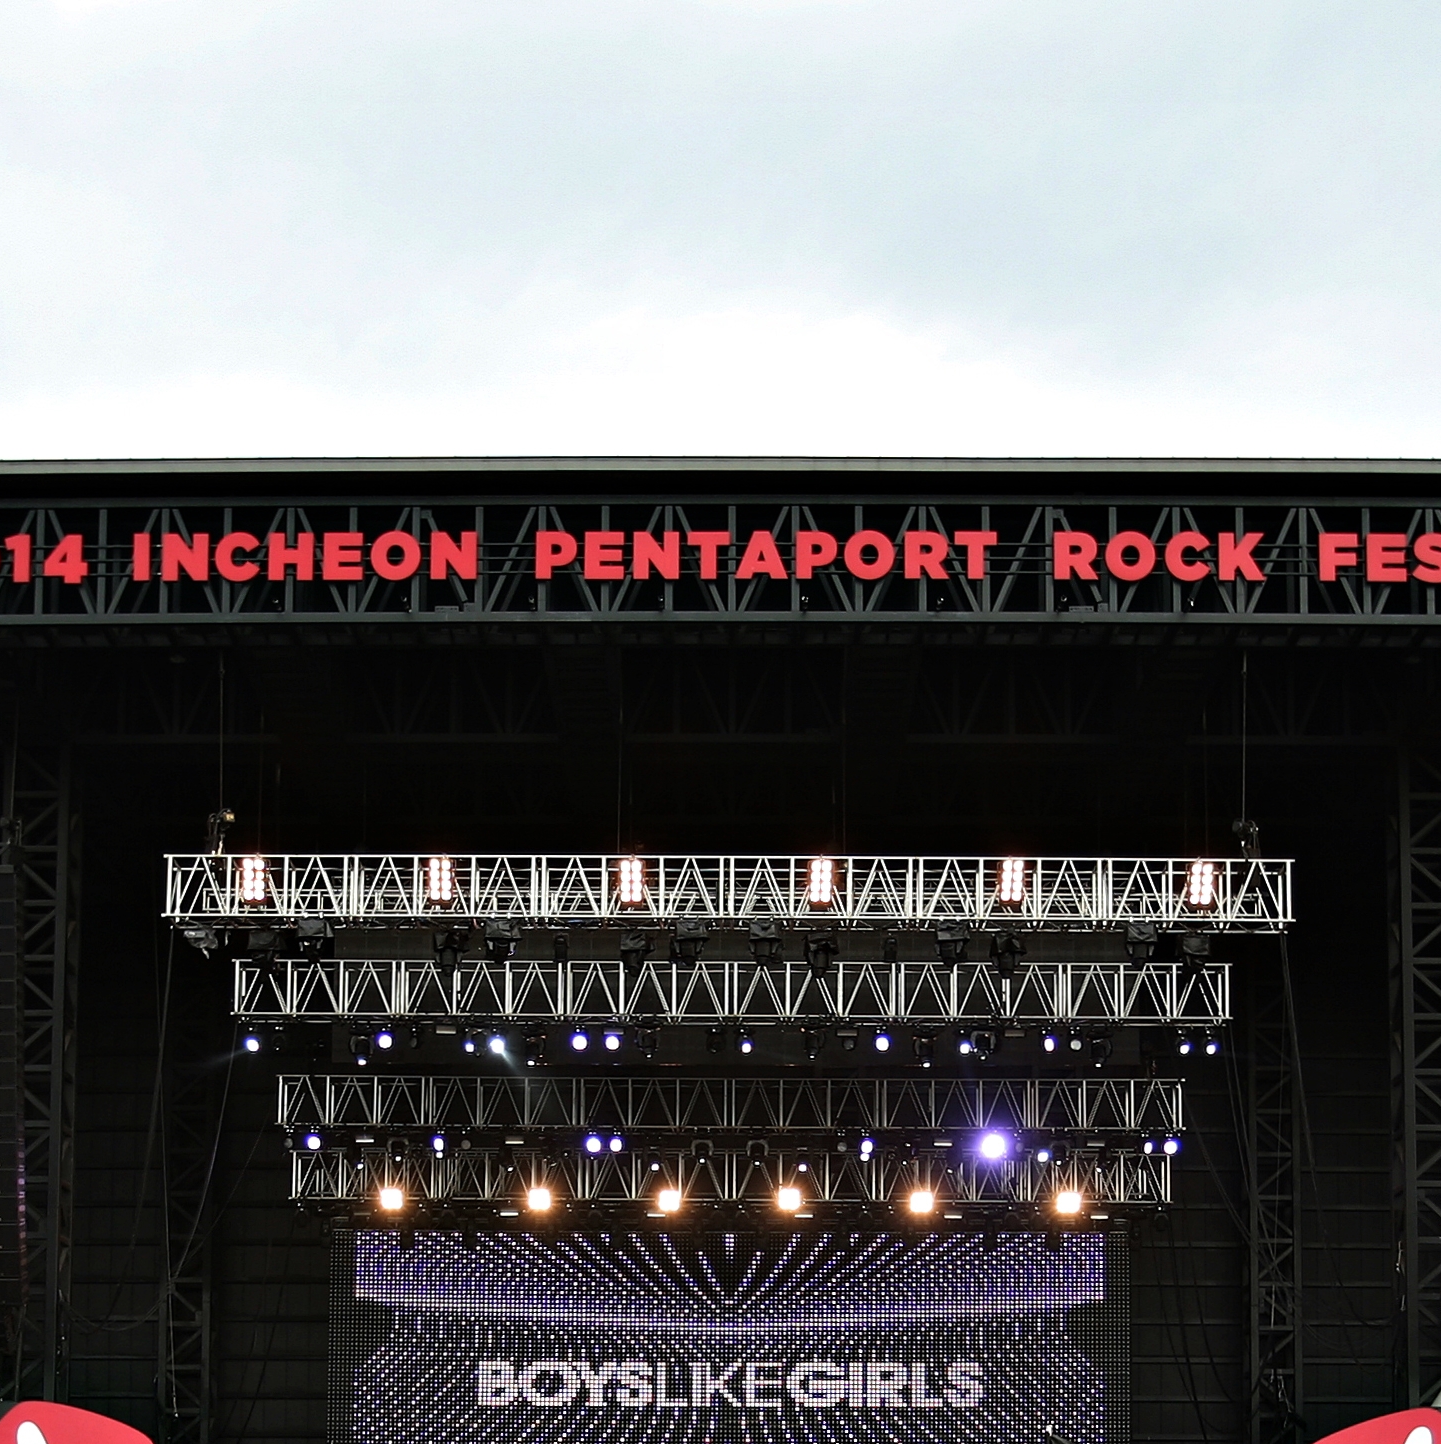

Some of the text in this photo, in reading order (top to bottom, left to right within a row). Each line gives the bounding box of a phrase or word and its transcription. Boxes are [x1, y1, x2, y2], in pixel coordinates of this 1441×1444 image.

[133, 531, 478, 582] INCHEON
[535, 530, 998, 580] PENTAPORT
[1053, 530, 1266, 581] ROCK
